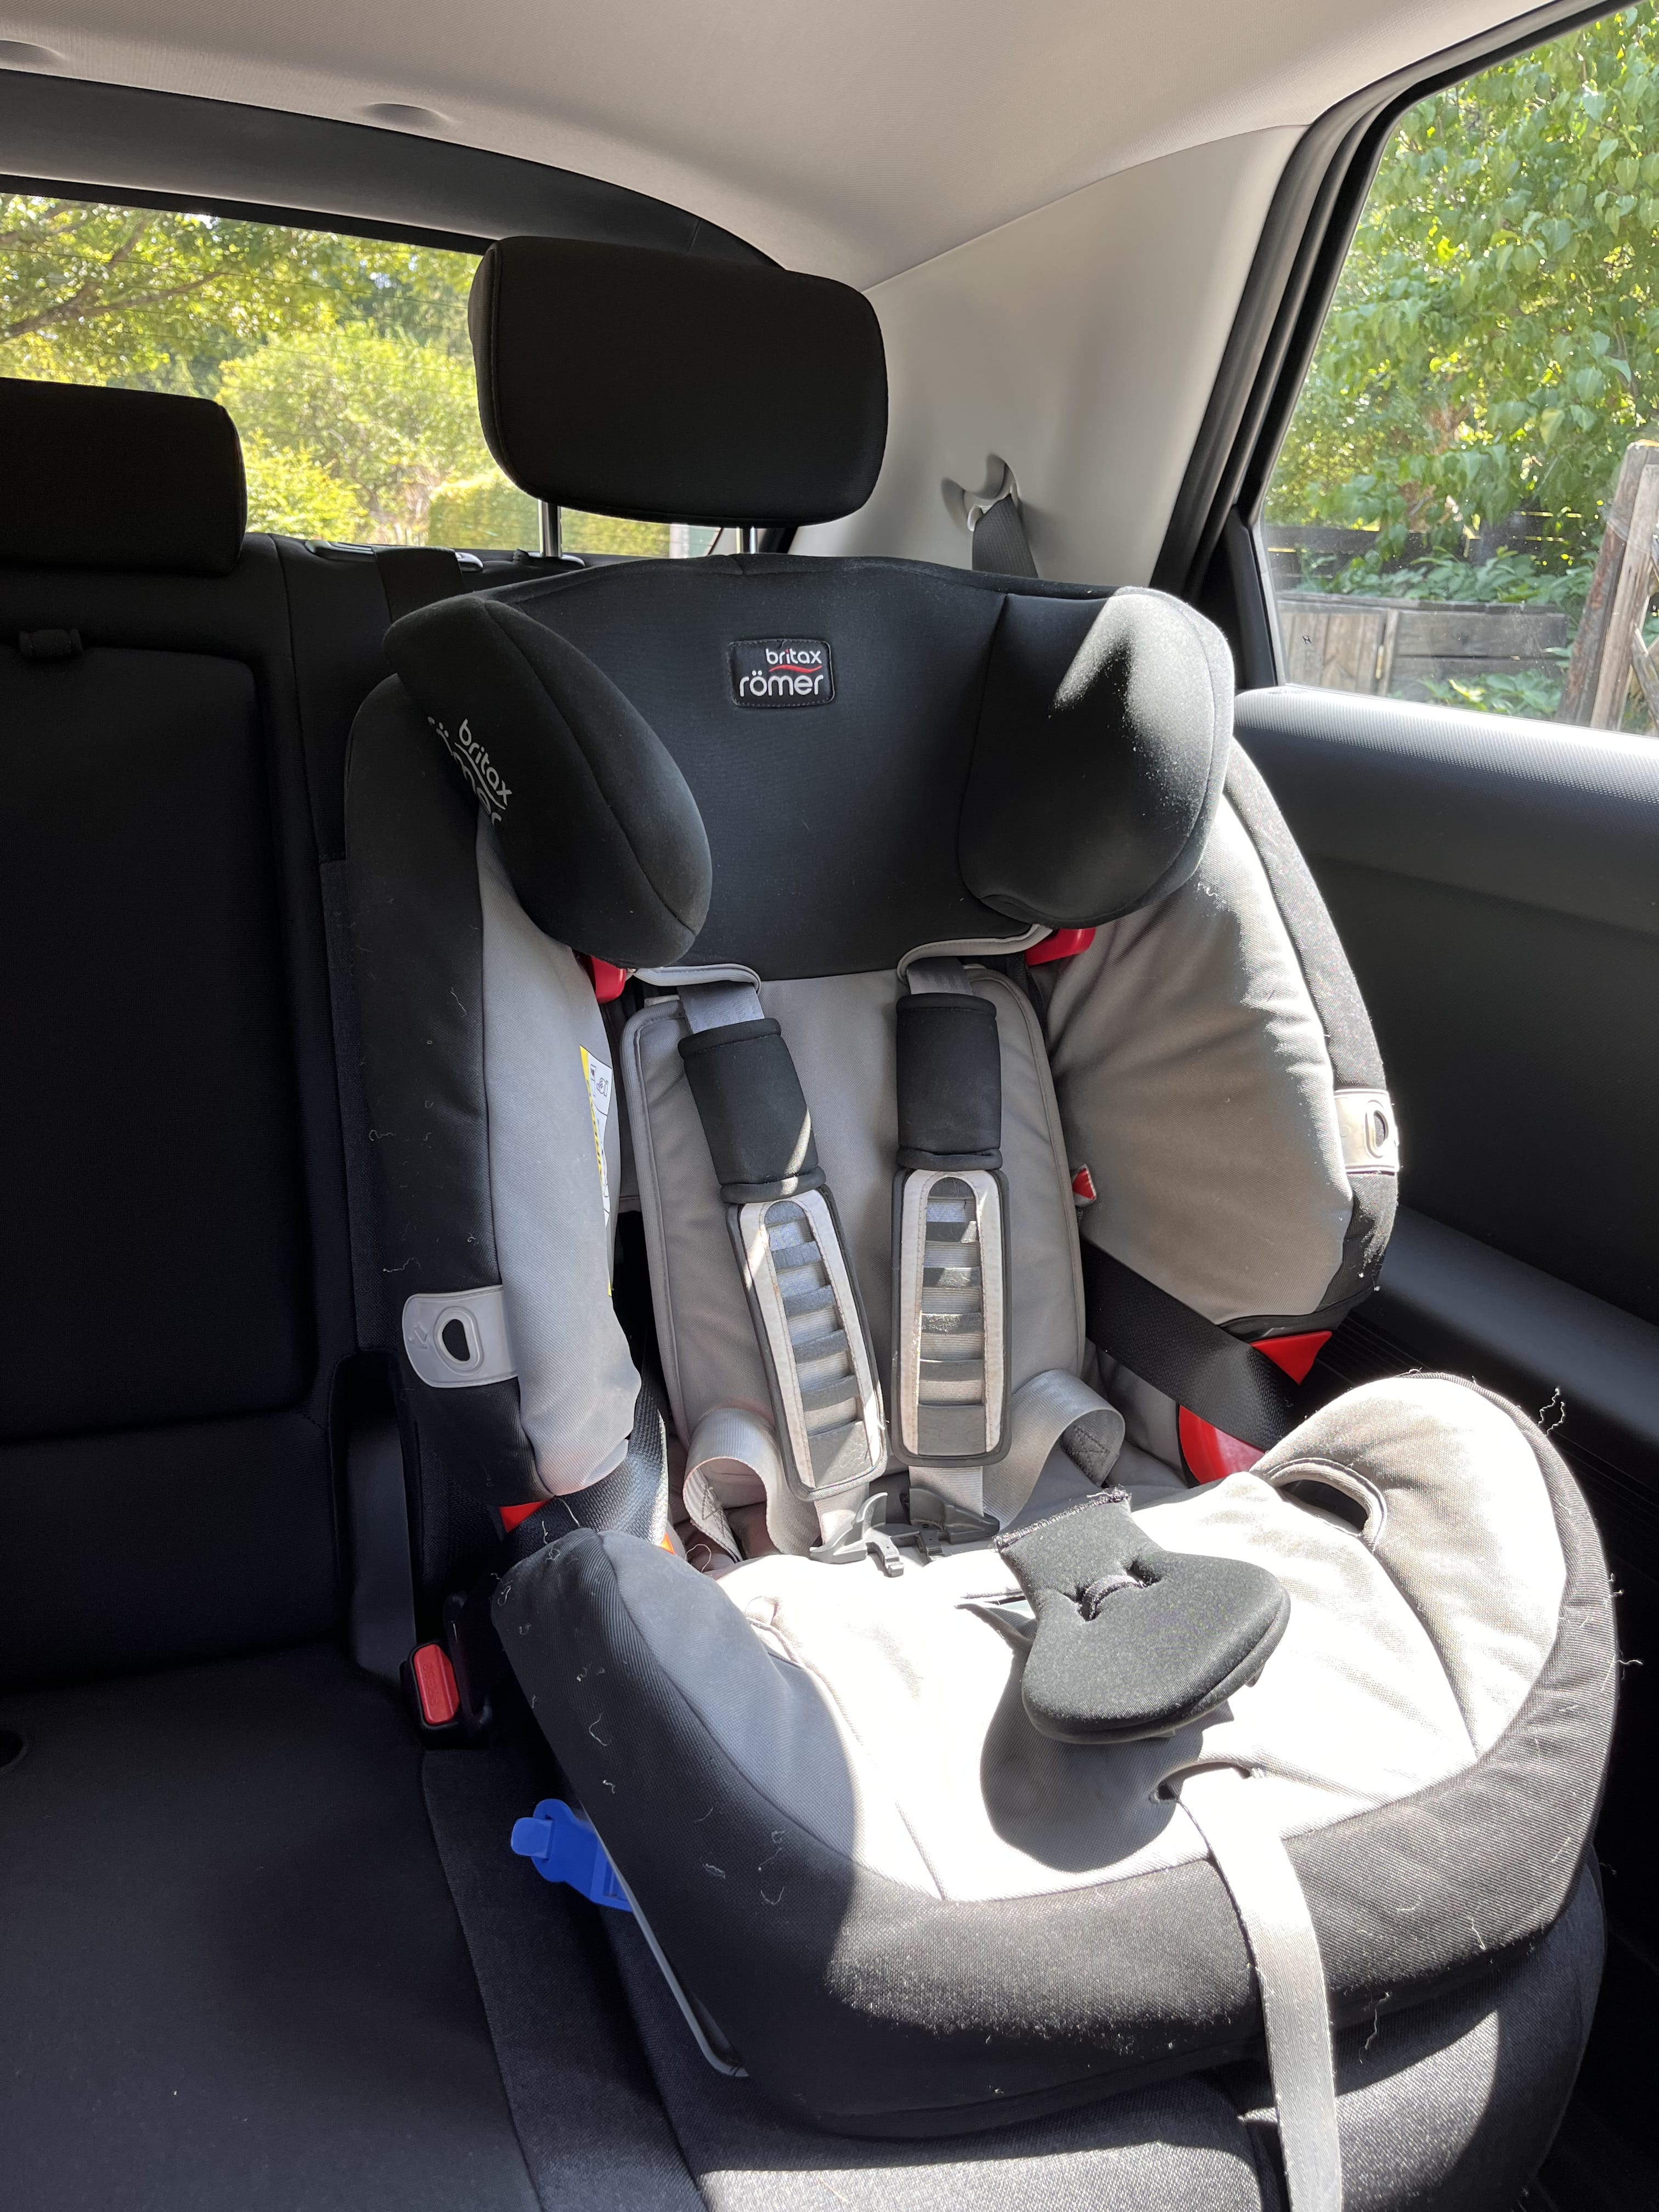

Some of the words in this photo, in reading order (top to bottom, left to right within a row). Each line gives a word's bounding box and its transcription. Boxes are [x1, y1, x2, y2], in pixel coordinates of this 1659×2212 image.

[765, 648, 822, 664] britax
[740, 670, 823, 697] römer
[459, 719, 512, 806] britax
